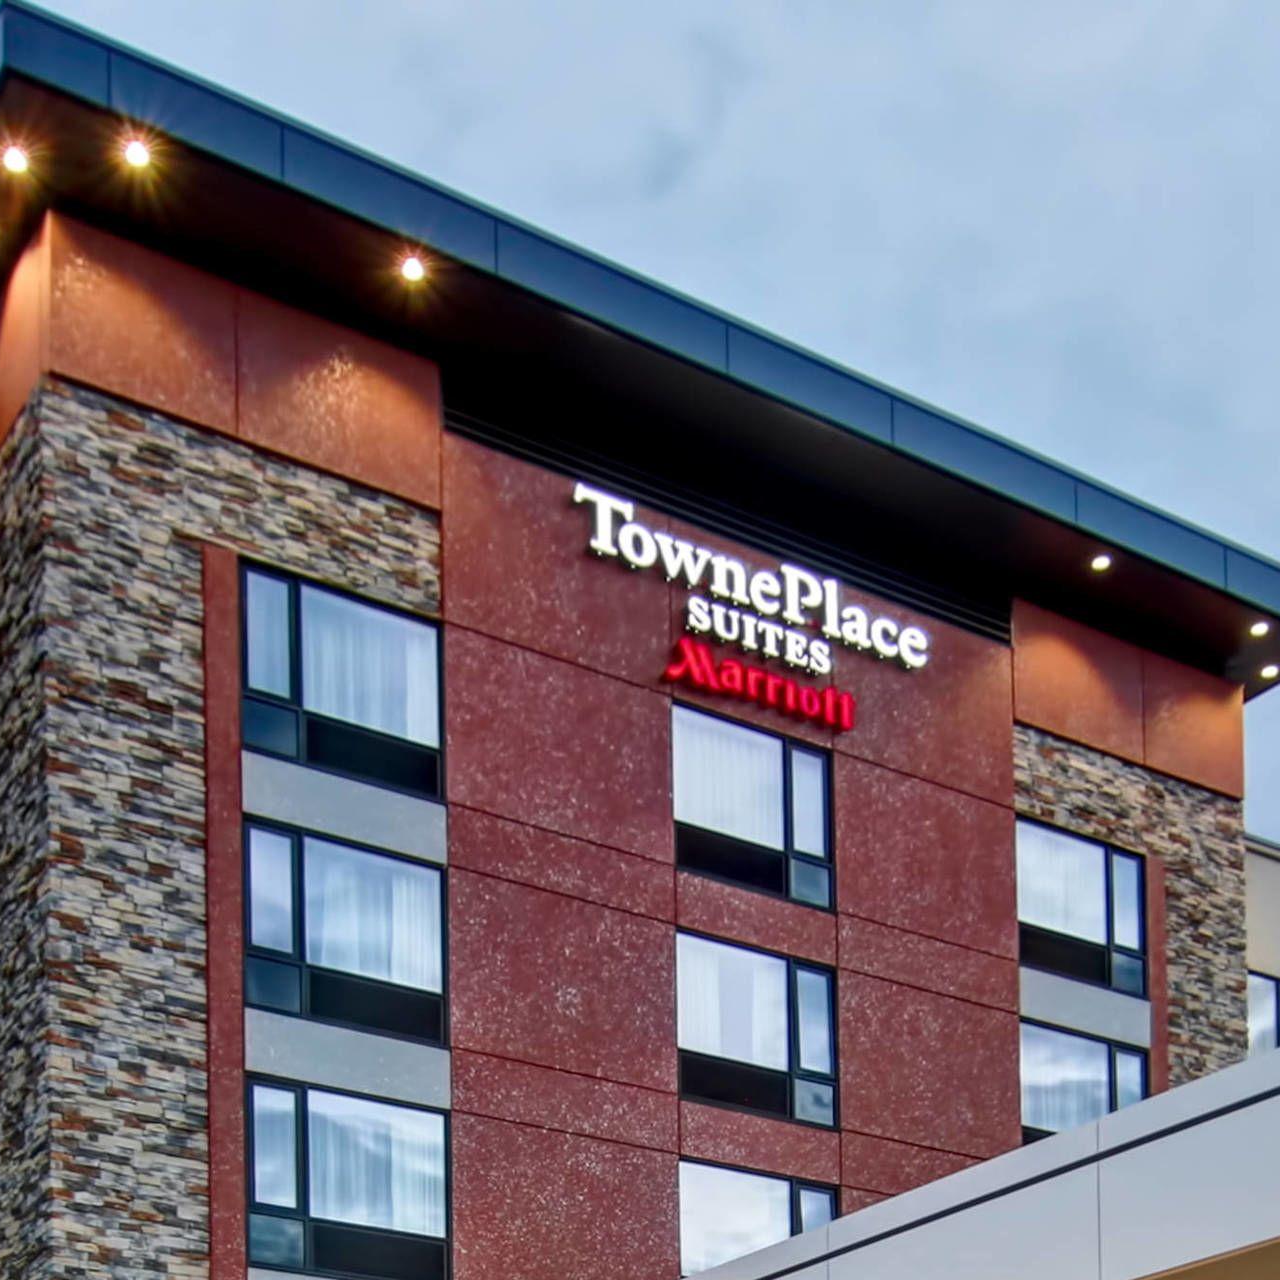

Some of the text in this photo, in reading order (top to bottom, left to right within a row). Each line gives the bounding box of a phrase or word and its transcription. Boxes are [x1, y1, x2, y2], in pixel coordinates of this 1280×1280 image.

[573, 482, 929, 669] TownePlace
[686, 595, 832, 675] SUITES
[662, 636, 856, 732] Marriott
